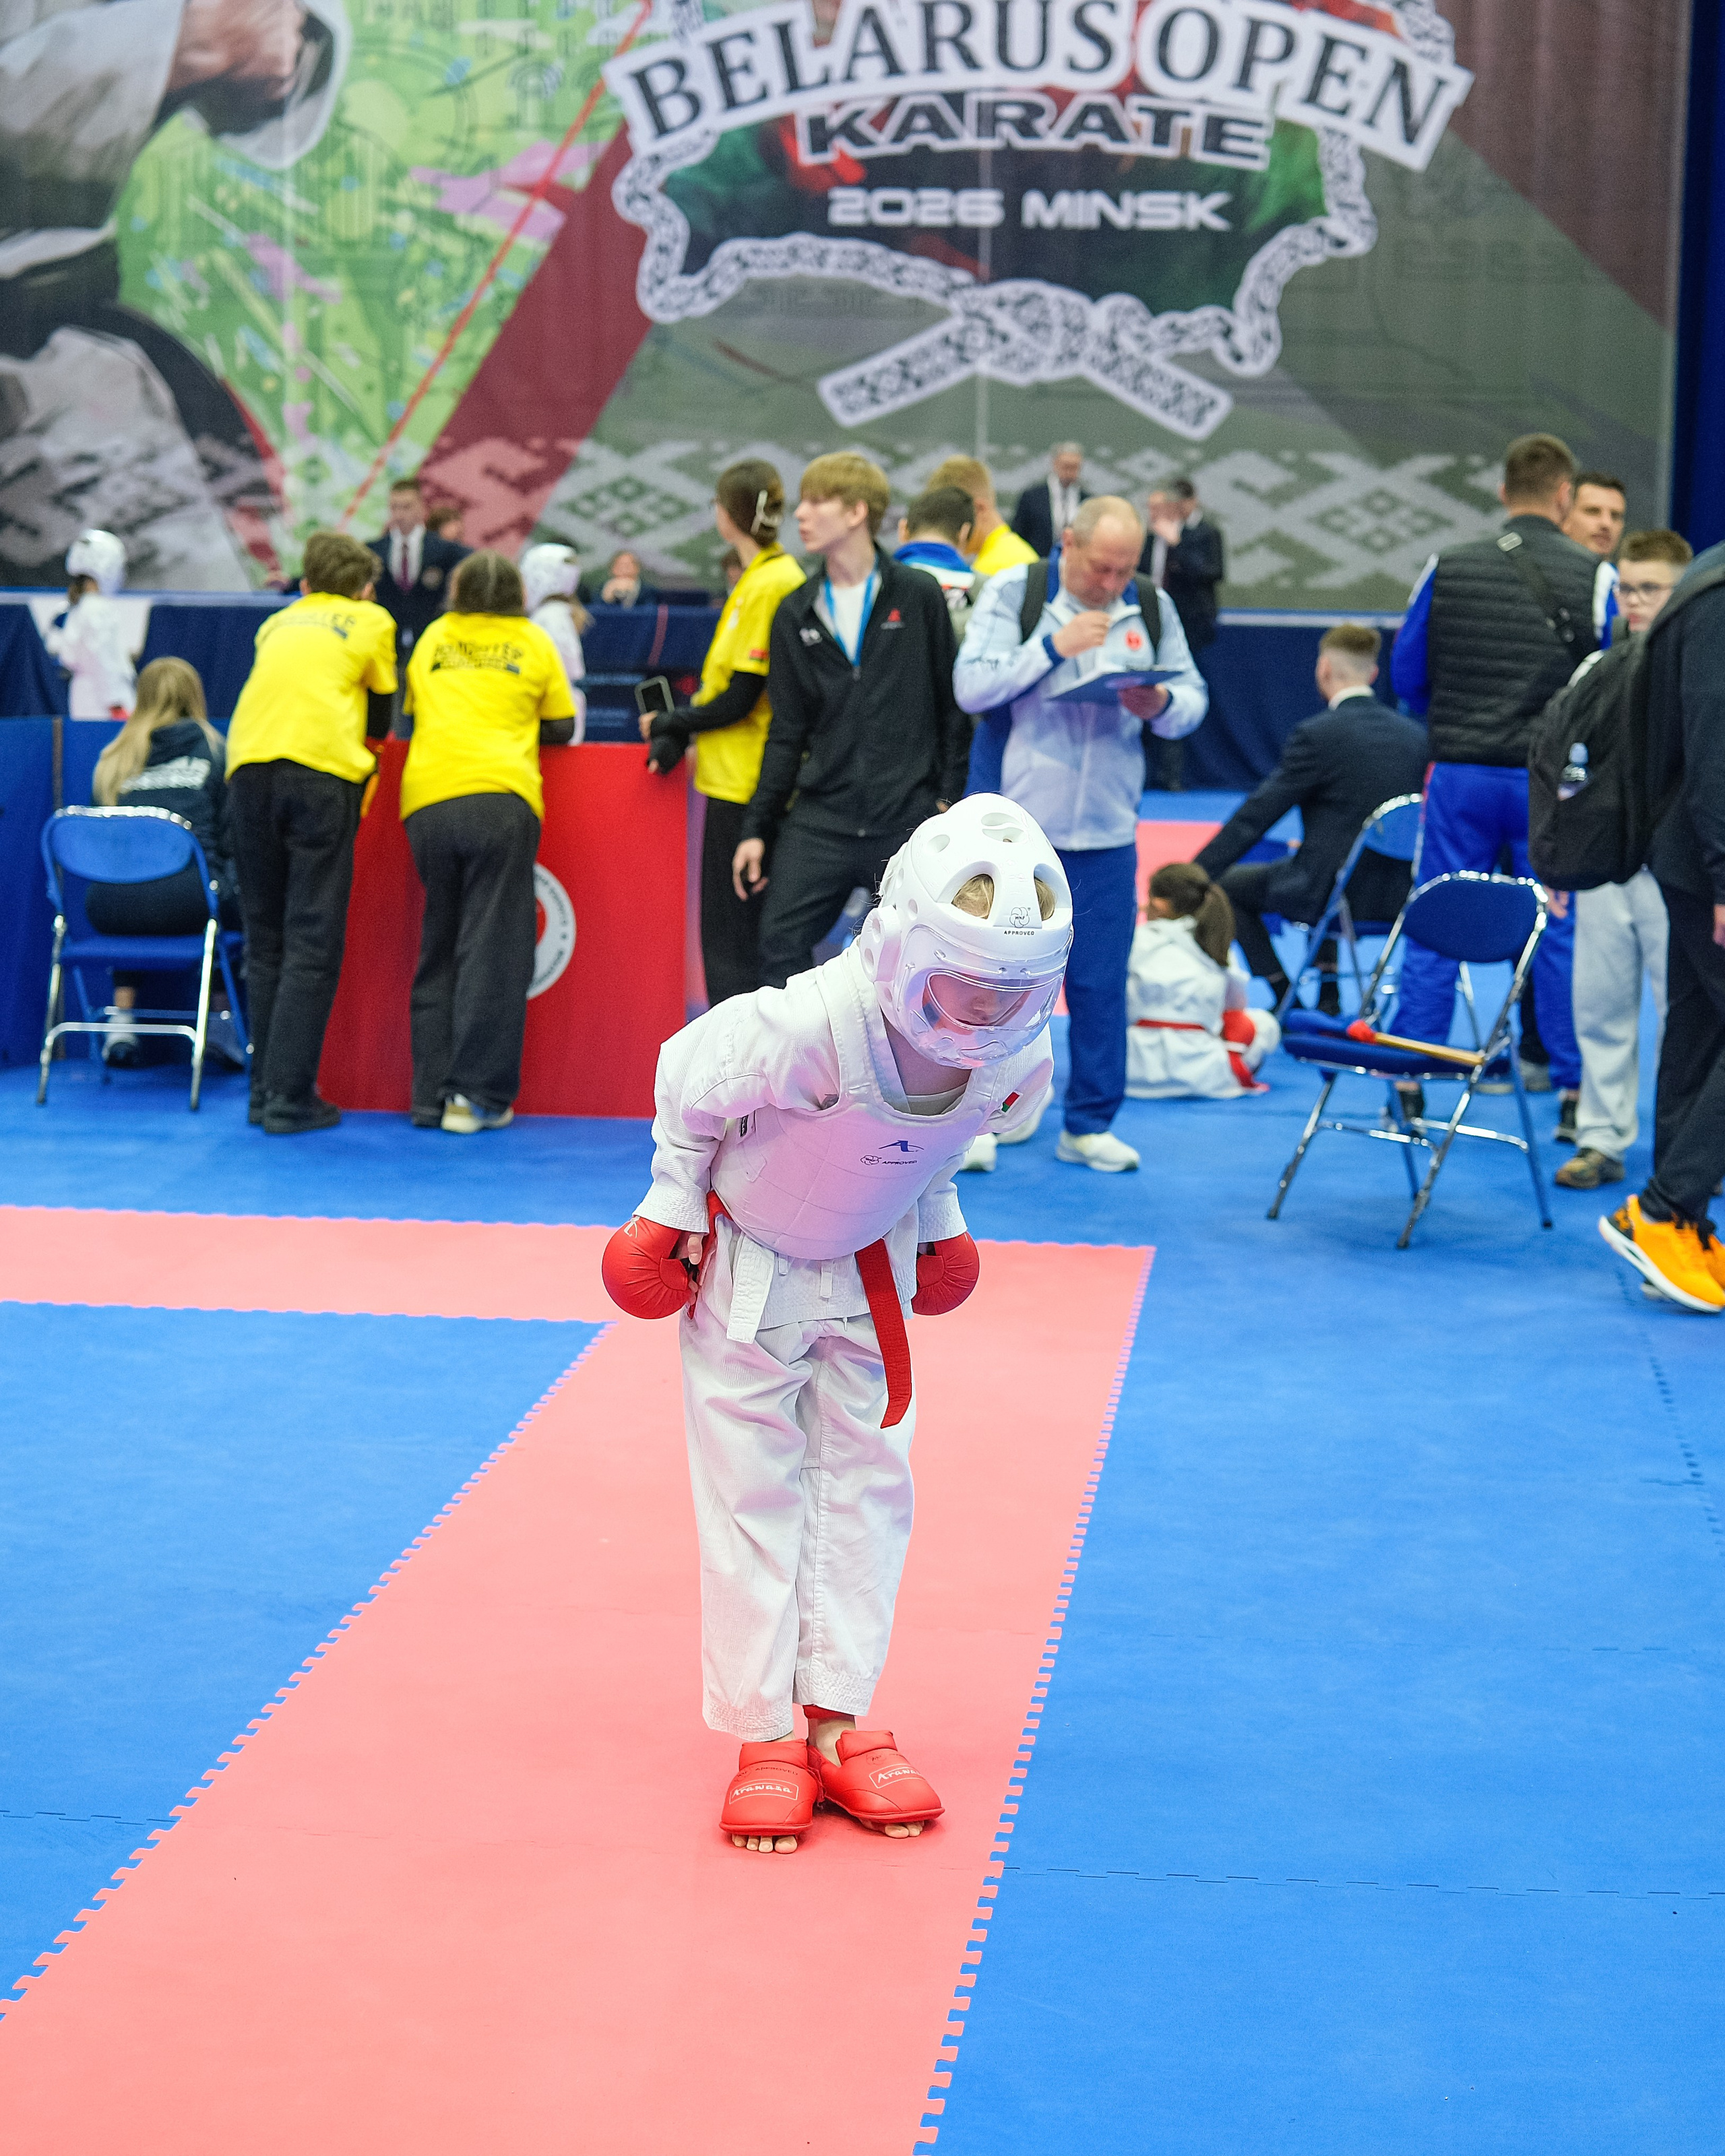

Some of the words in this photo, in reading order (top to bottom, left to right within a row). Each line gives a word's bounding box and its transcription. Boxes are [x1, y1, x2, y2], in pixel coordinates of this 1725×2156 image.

[628, 0, 1120, 139] BELARUS
[1155, 7, 1449, 146] OPEN
[805, 96, 1271, 164] KARATE
[827, 185, 1005, 227] 2026
[1021, 189, 1232, 232] MINSK
[877, 1767, 921, 1784] Arawa
